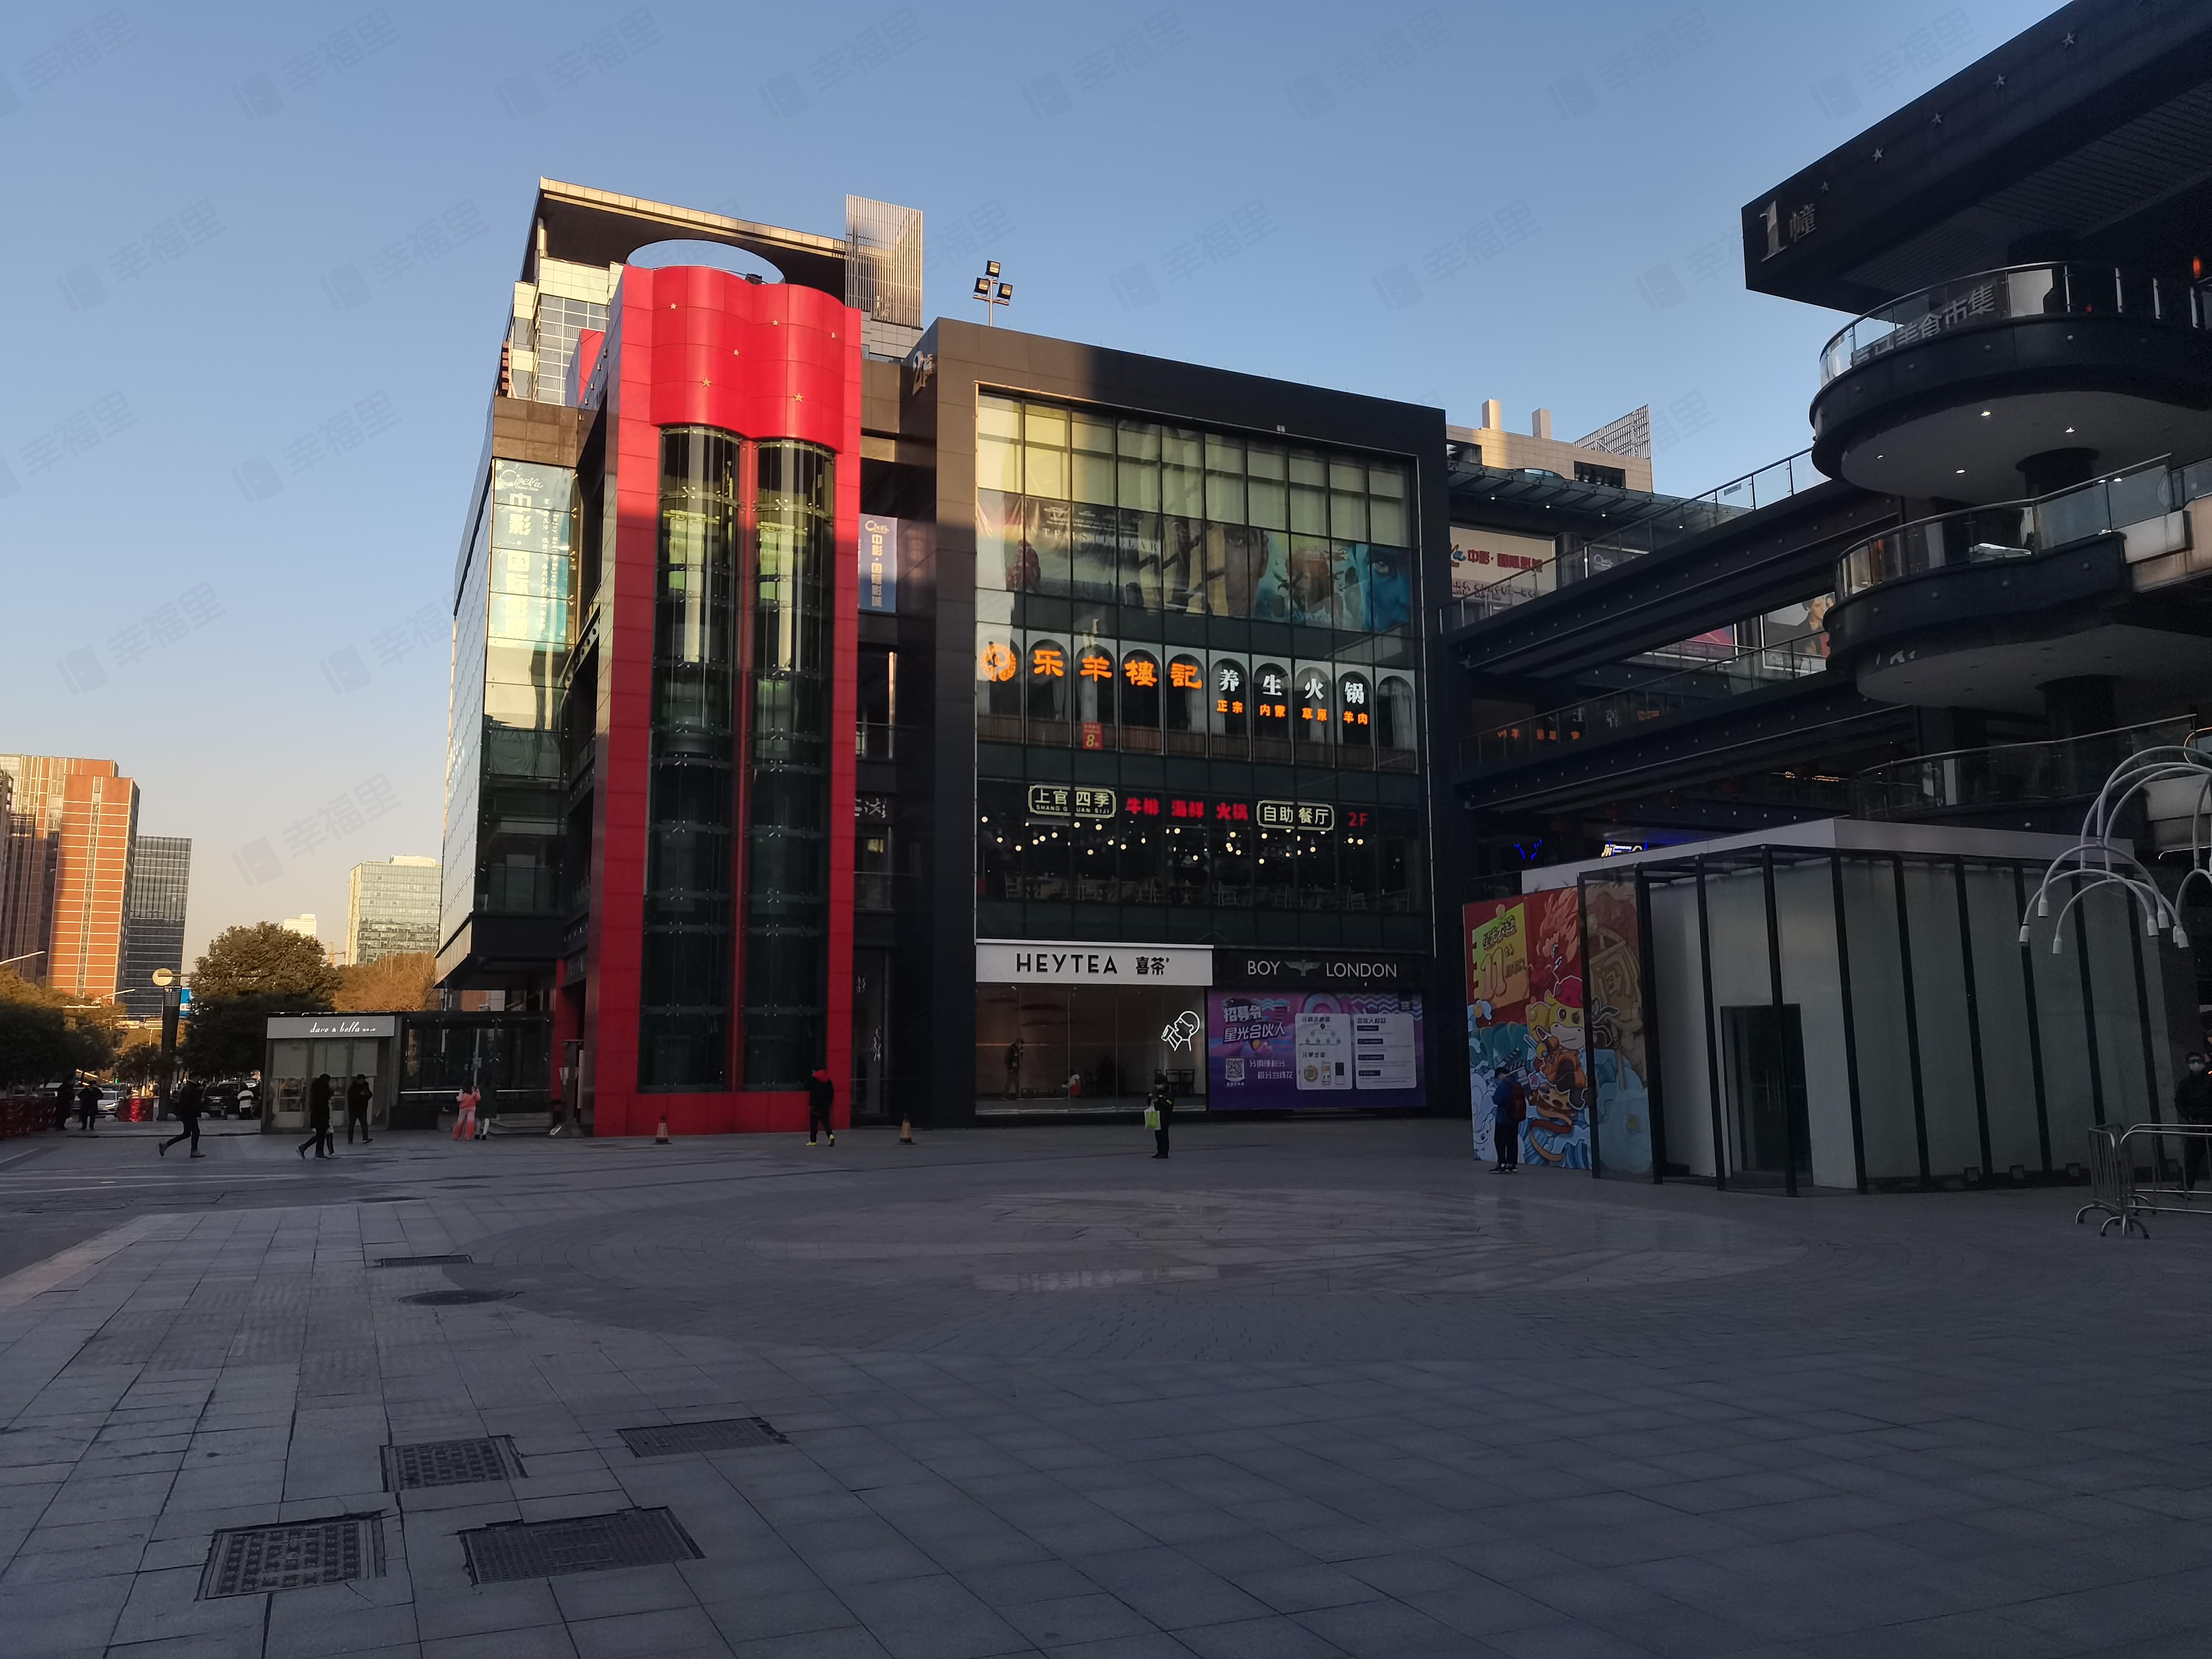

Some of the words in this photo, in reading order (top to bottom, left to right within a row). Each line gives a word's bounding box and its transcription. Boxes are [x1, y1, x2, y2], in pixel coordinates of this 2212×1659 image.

[1759, 200, 1817, 262] 1幢
[1219, 669, 1364, 705] 养生火锅
[1216, 699, 1245, 714] 正宗
[1343, 710, 1369, 725] 羊肉
[1263, 805, 1329, 825] 自助餐厅
[1348, 811, 1368, 827] 2F
[1016, 953, 1118, 974] HEYTEA
[1248, 960, 1280, 975] BOY
[1326, 962, 1397, 977] LONDON
[310, 1022, 329, 1033] dave
[339, 1021, 360, 1033] bella
[1224, 1022, 1286, 1043] 星光合伙人
